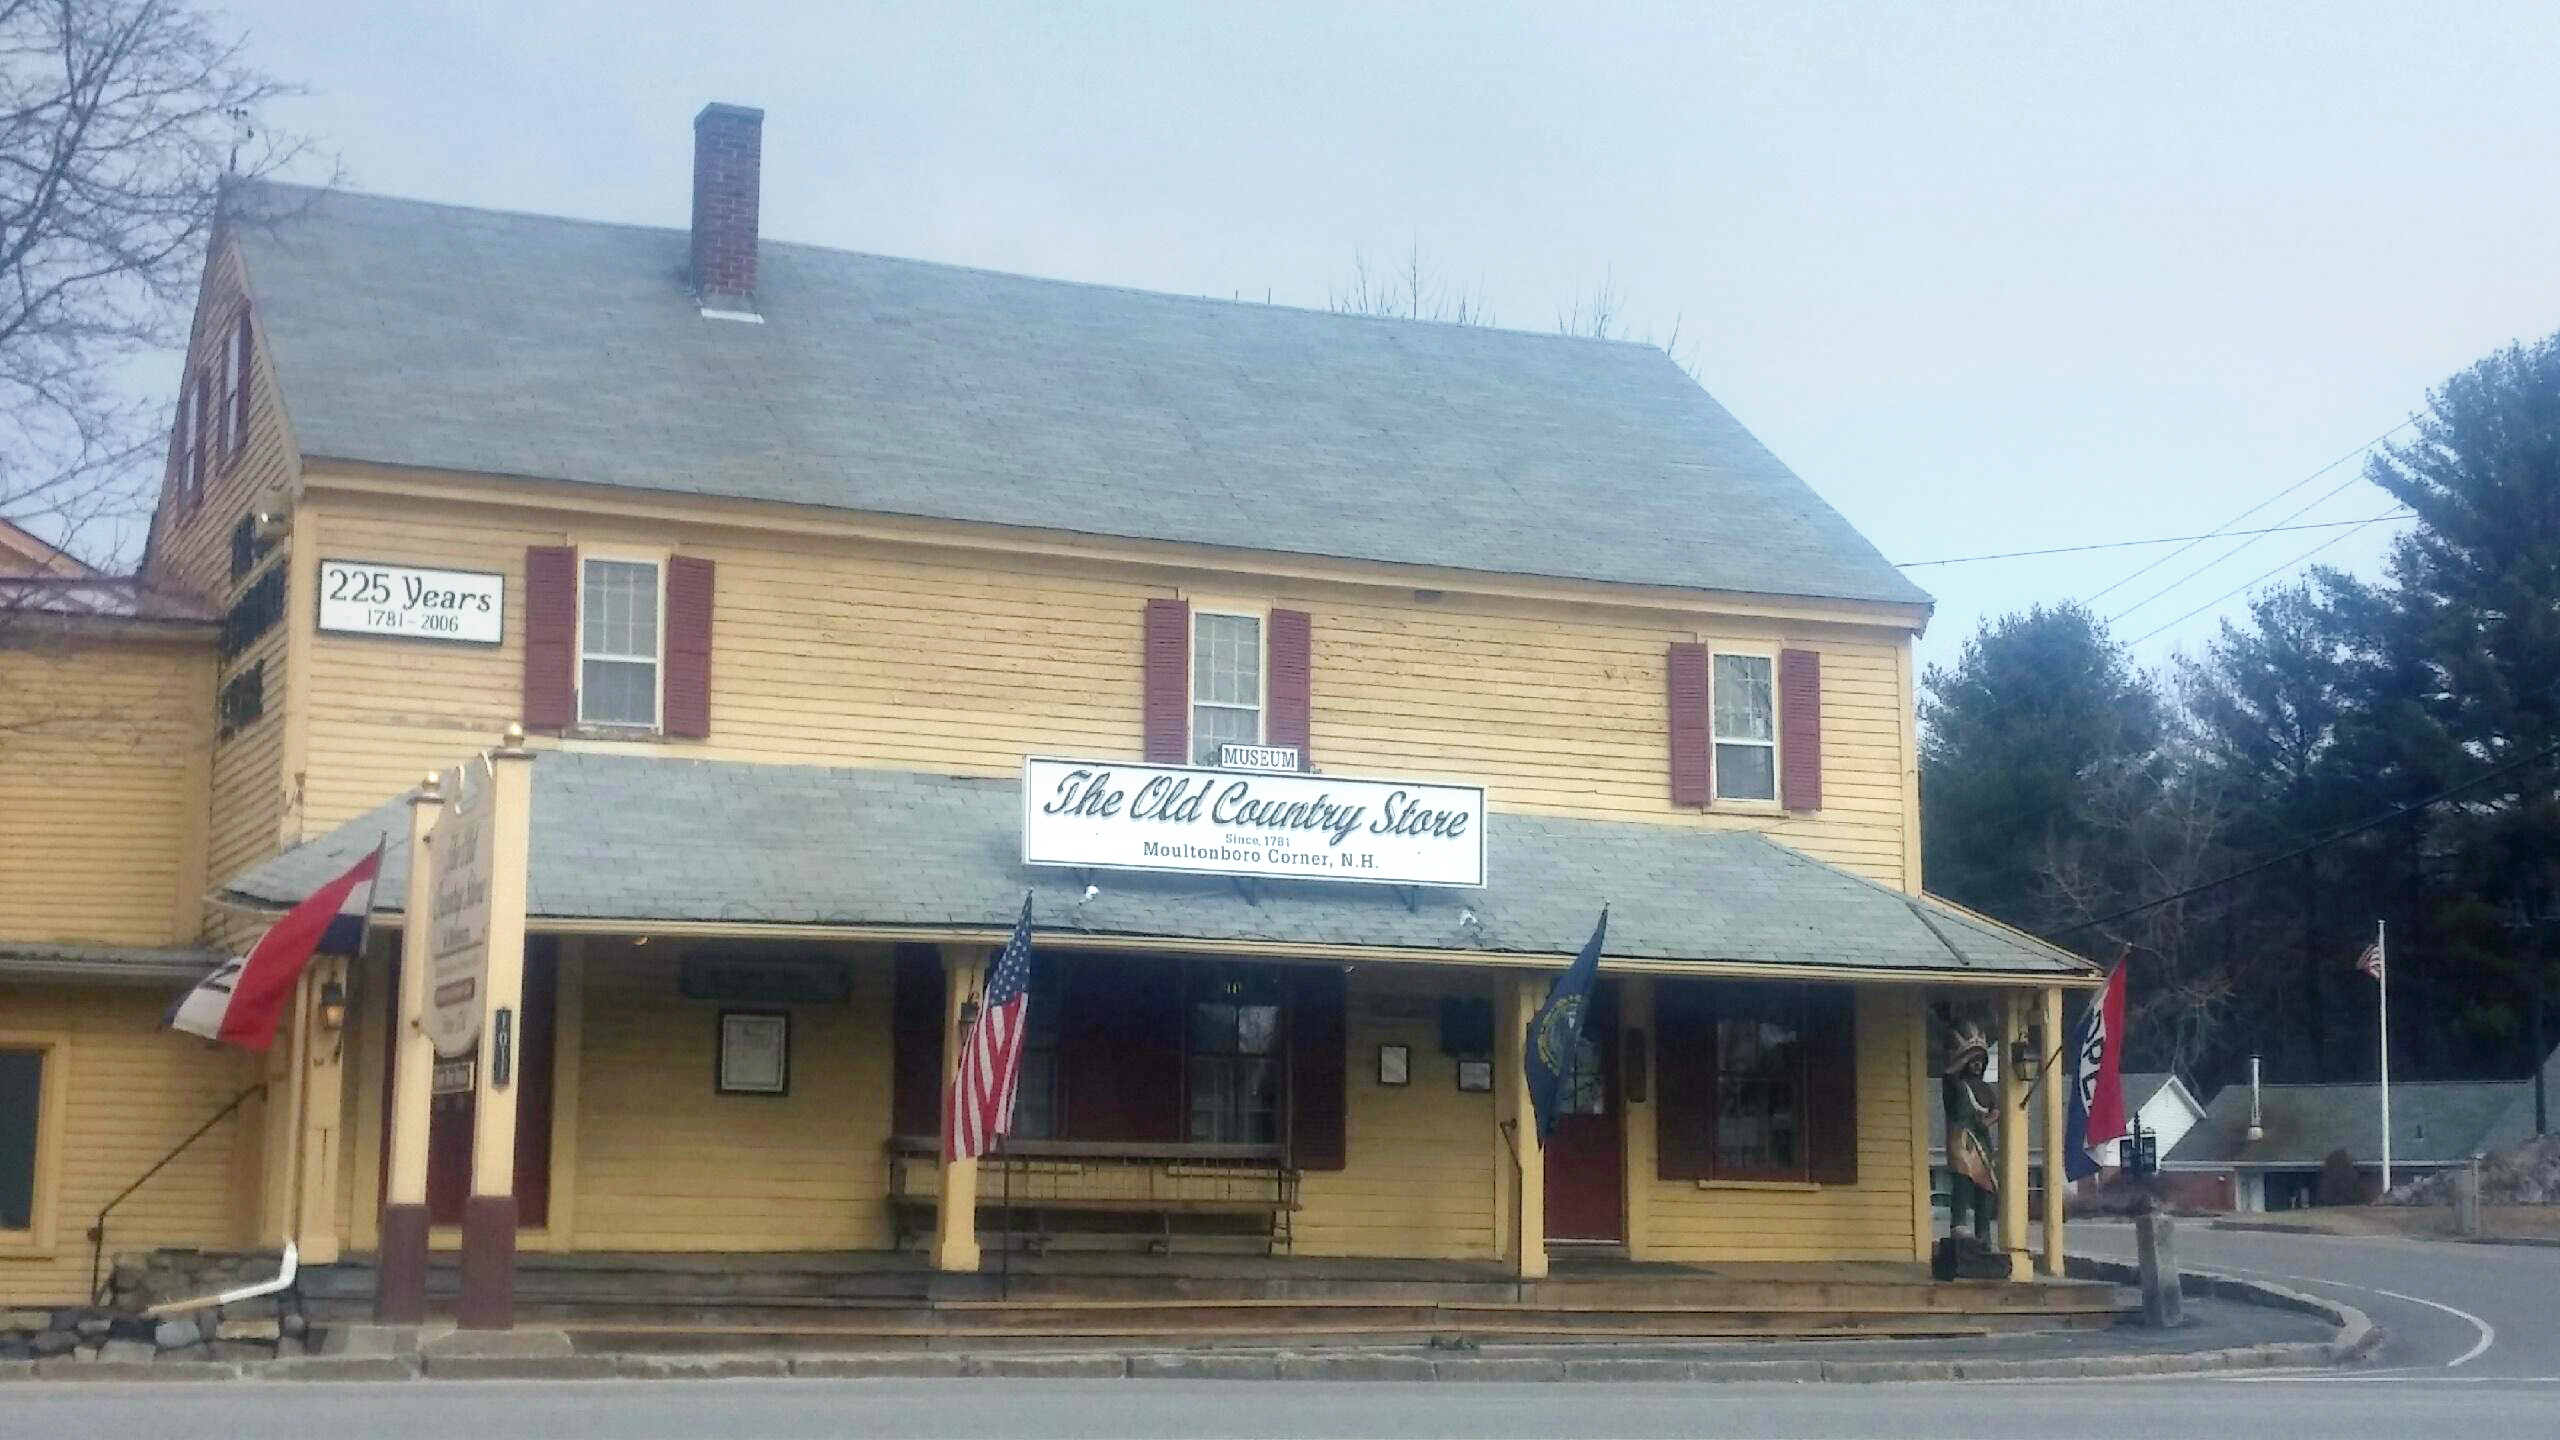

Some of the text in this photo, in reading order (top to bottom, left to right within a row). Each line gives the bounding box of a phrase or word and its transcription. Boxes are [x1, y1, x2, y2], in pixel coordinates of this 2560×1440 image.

[329, 569, 492, 612] 225 Years
[1223, 748, 1295, 768] MUSEUM
[1044, 770, 1470, 847] The Old Country Store
[1143, 841, 1379, 869] Moultonboro Corner, N.H.
[1264, 836, 1290, 847] 1781
